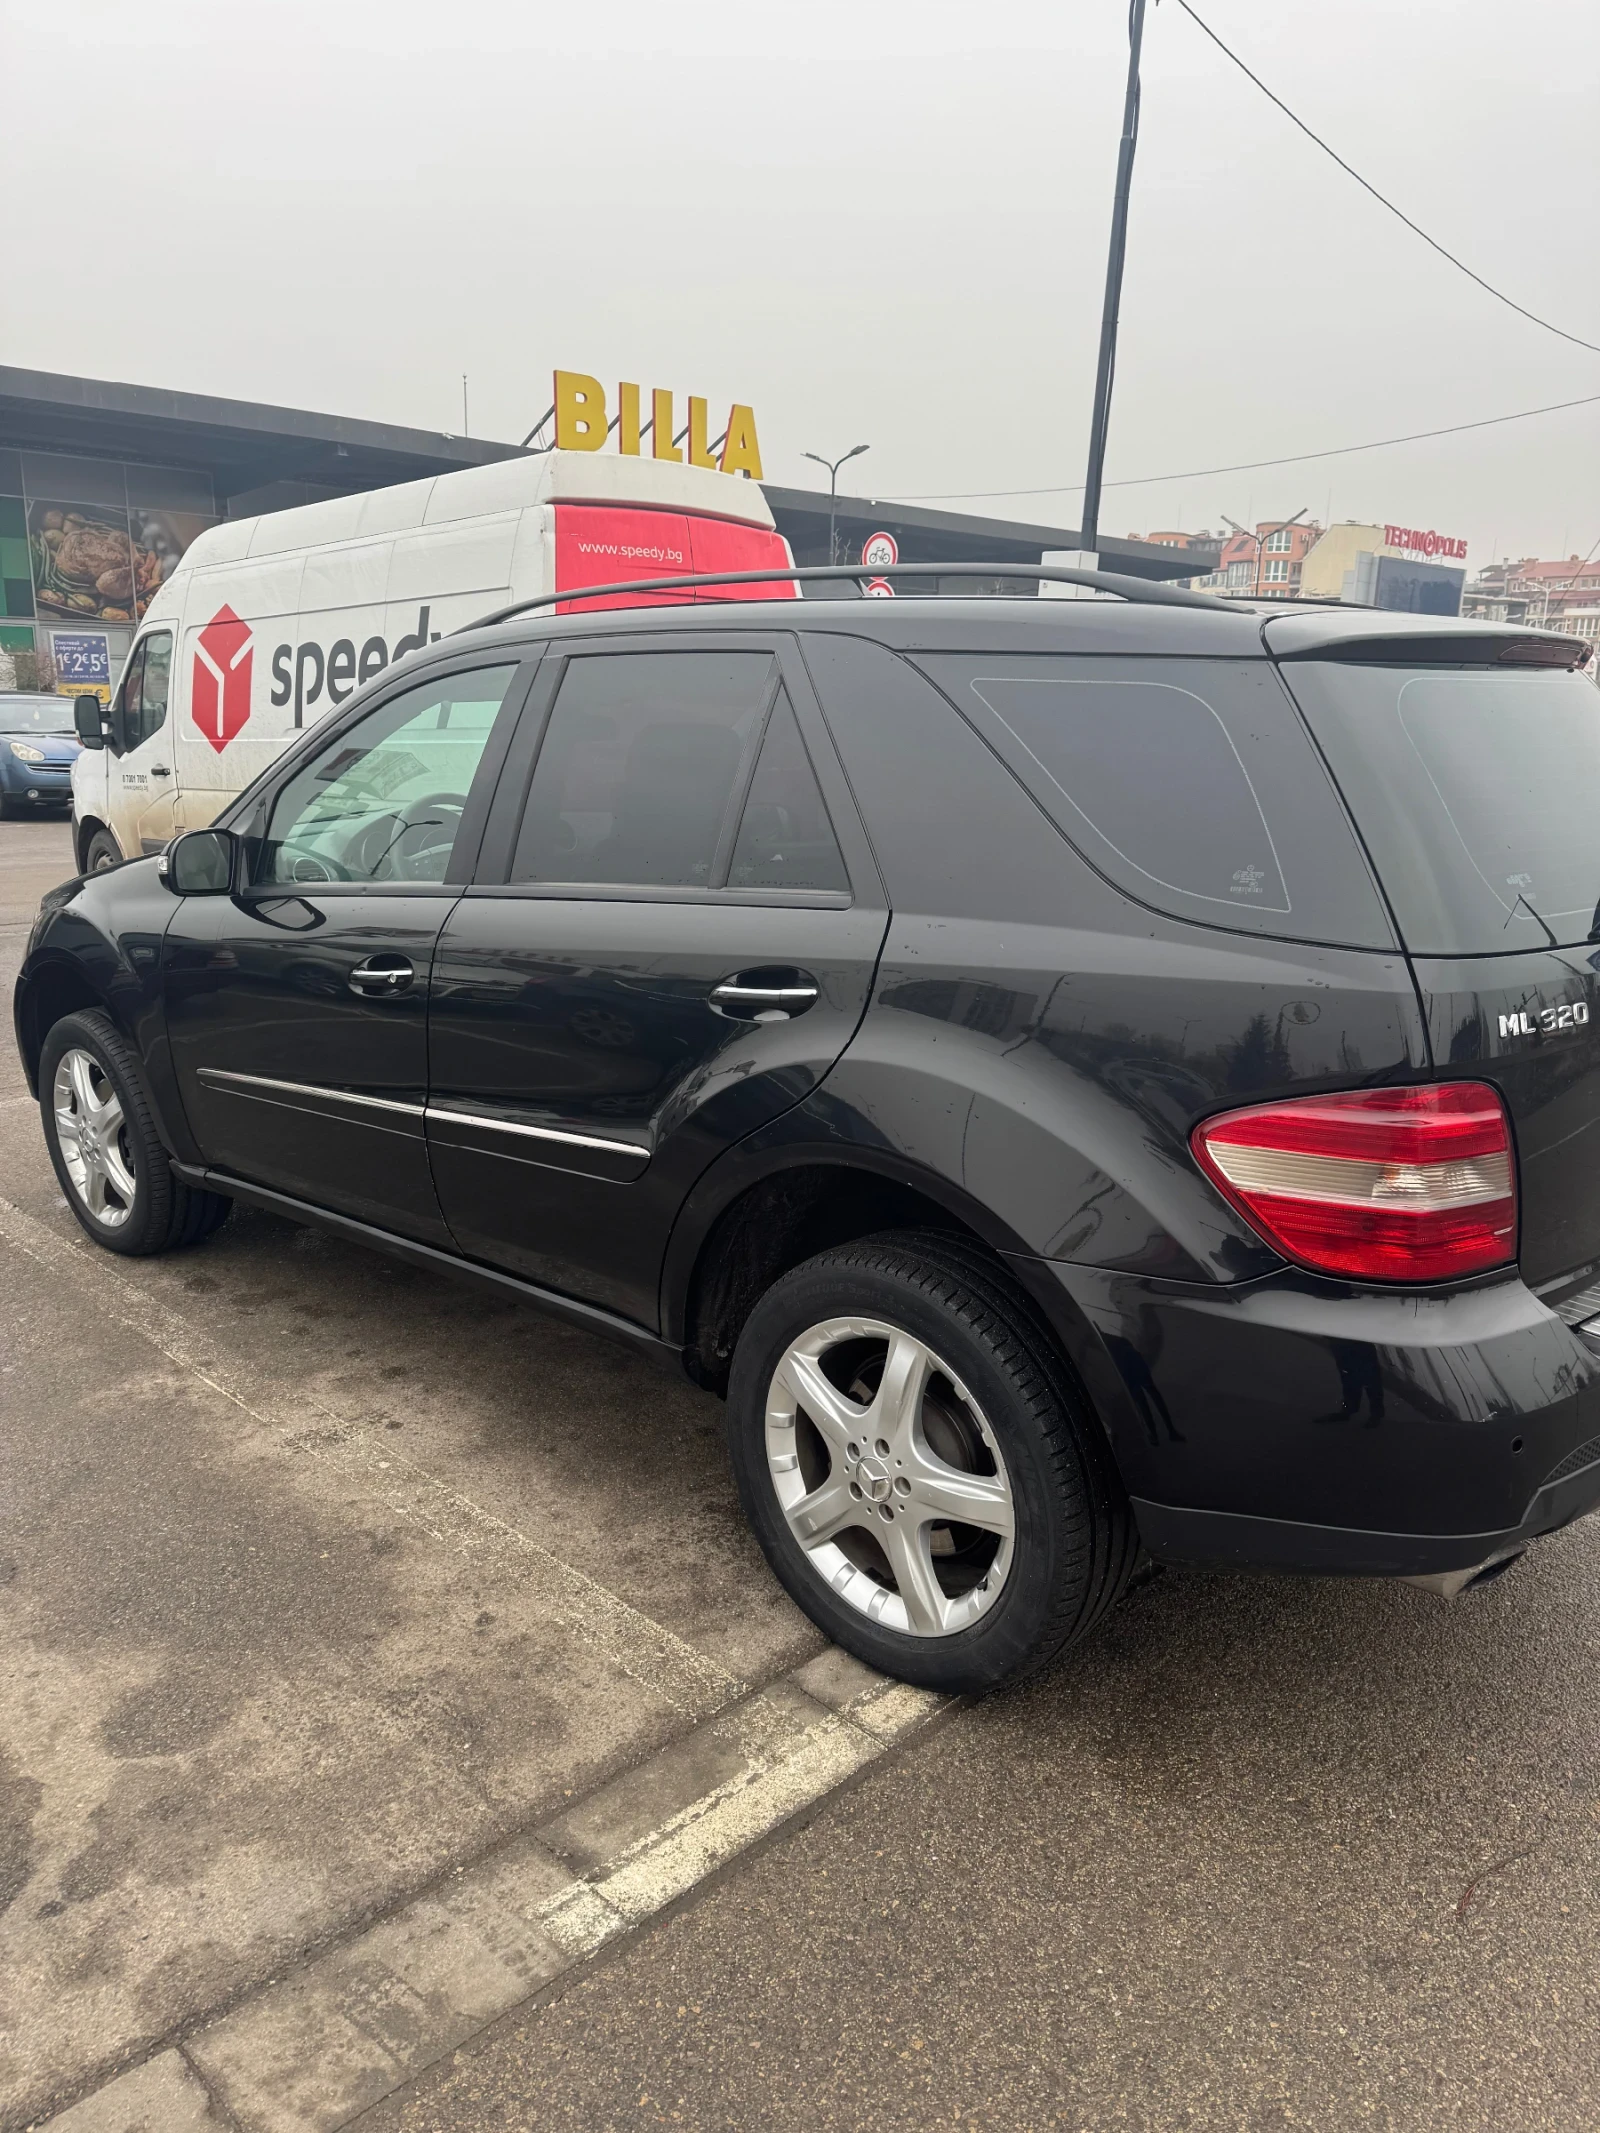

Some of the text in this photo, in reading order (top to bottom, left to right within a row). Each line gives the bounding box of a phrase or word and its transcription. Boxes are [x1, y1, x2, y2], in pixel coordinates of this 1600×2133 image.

[553, 369, 763, 480] BILLA
[578, 543, 683, 563] www.speedy.bg
[1384, 524, 1468, 559] TECHNOPOLIS
[270, 605, 442, 728] speed
[1498, 1002, 1590, 1037] ML 320
